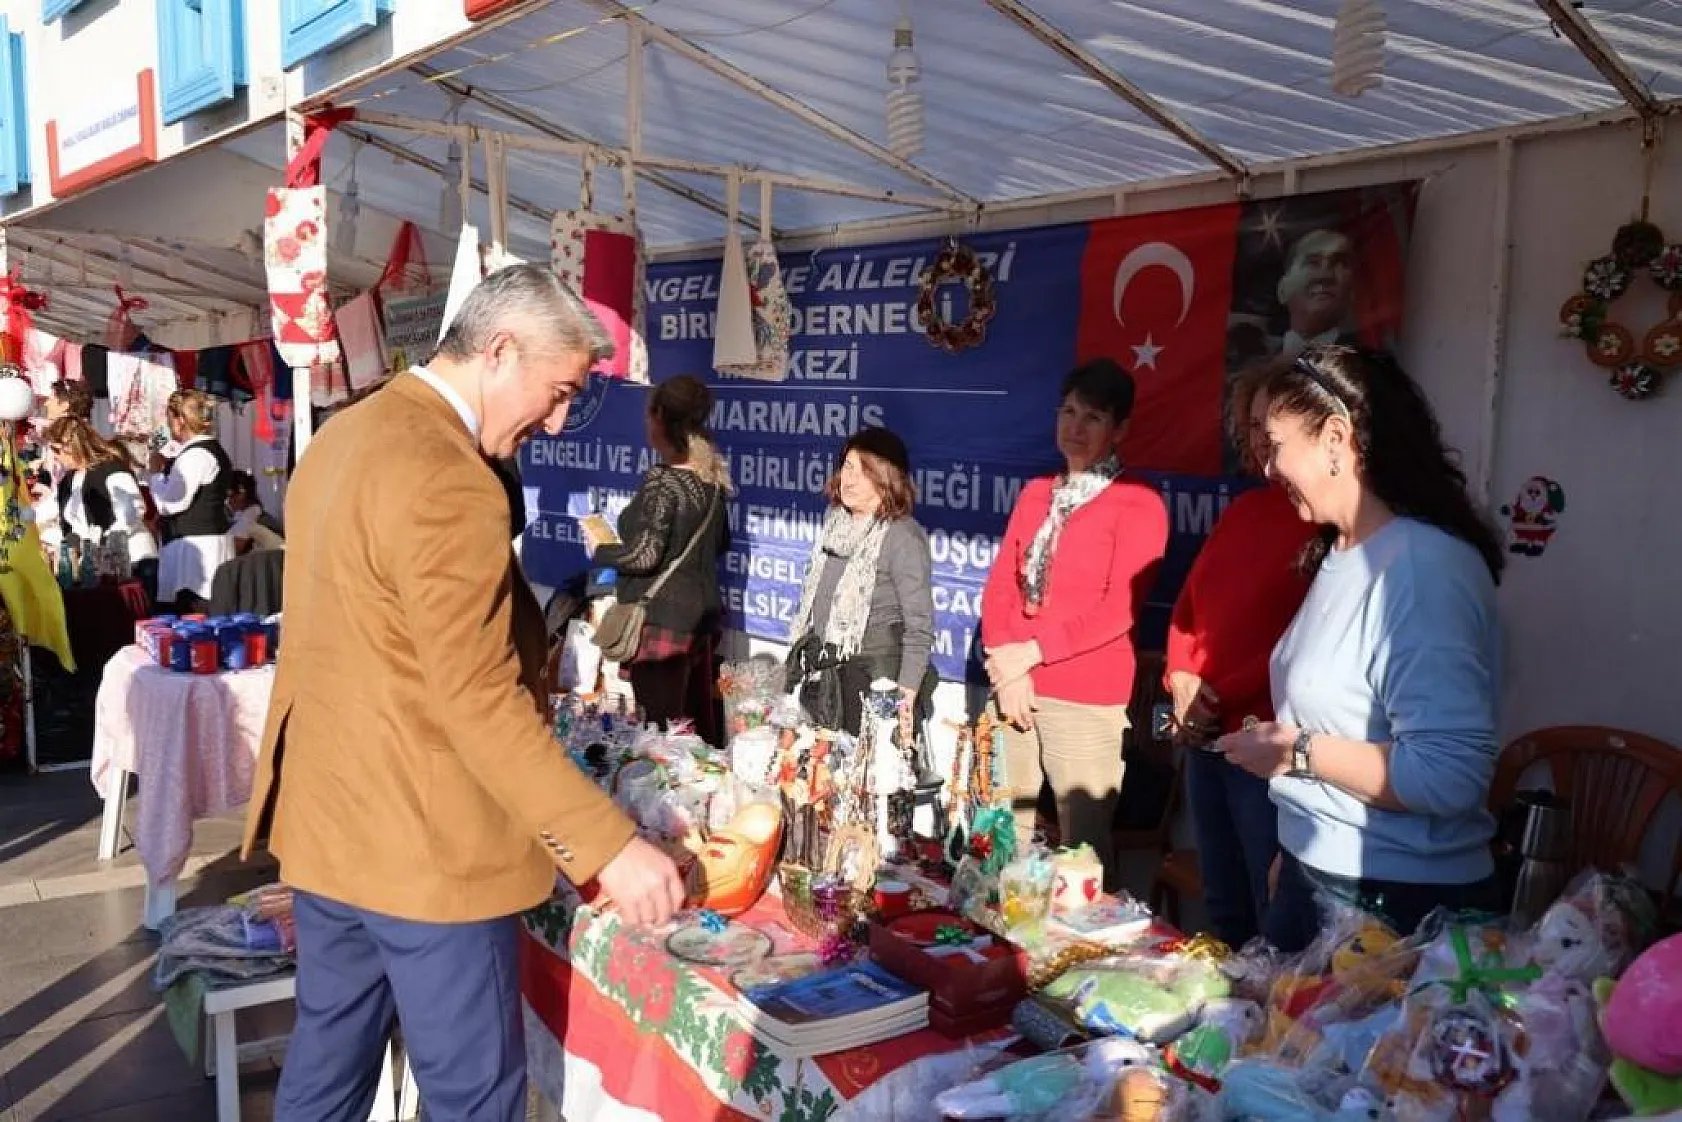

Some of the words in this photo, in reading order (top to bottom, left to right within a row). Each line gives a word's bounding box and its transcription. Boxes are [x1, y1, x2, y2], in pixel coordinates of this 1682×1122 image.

[703, 396, 886, 437] MARMARİS
[531, 437, 601, 471] ENGELLİ
[606, 444, 632, 474] VE
[725, 551, 810, 584] ENGEL
